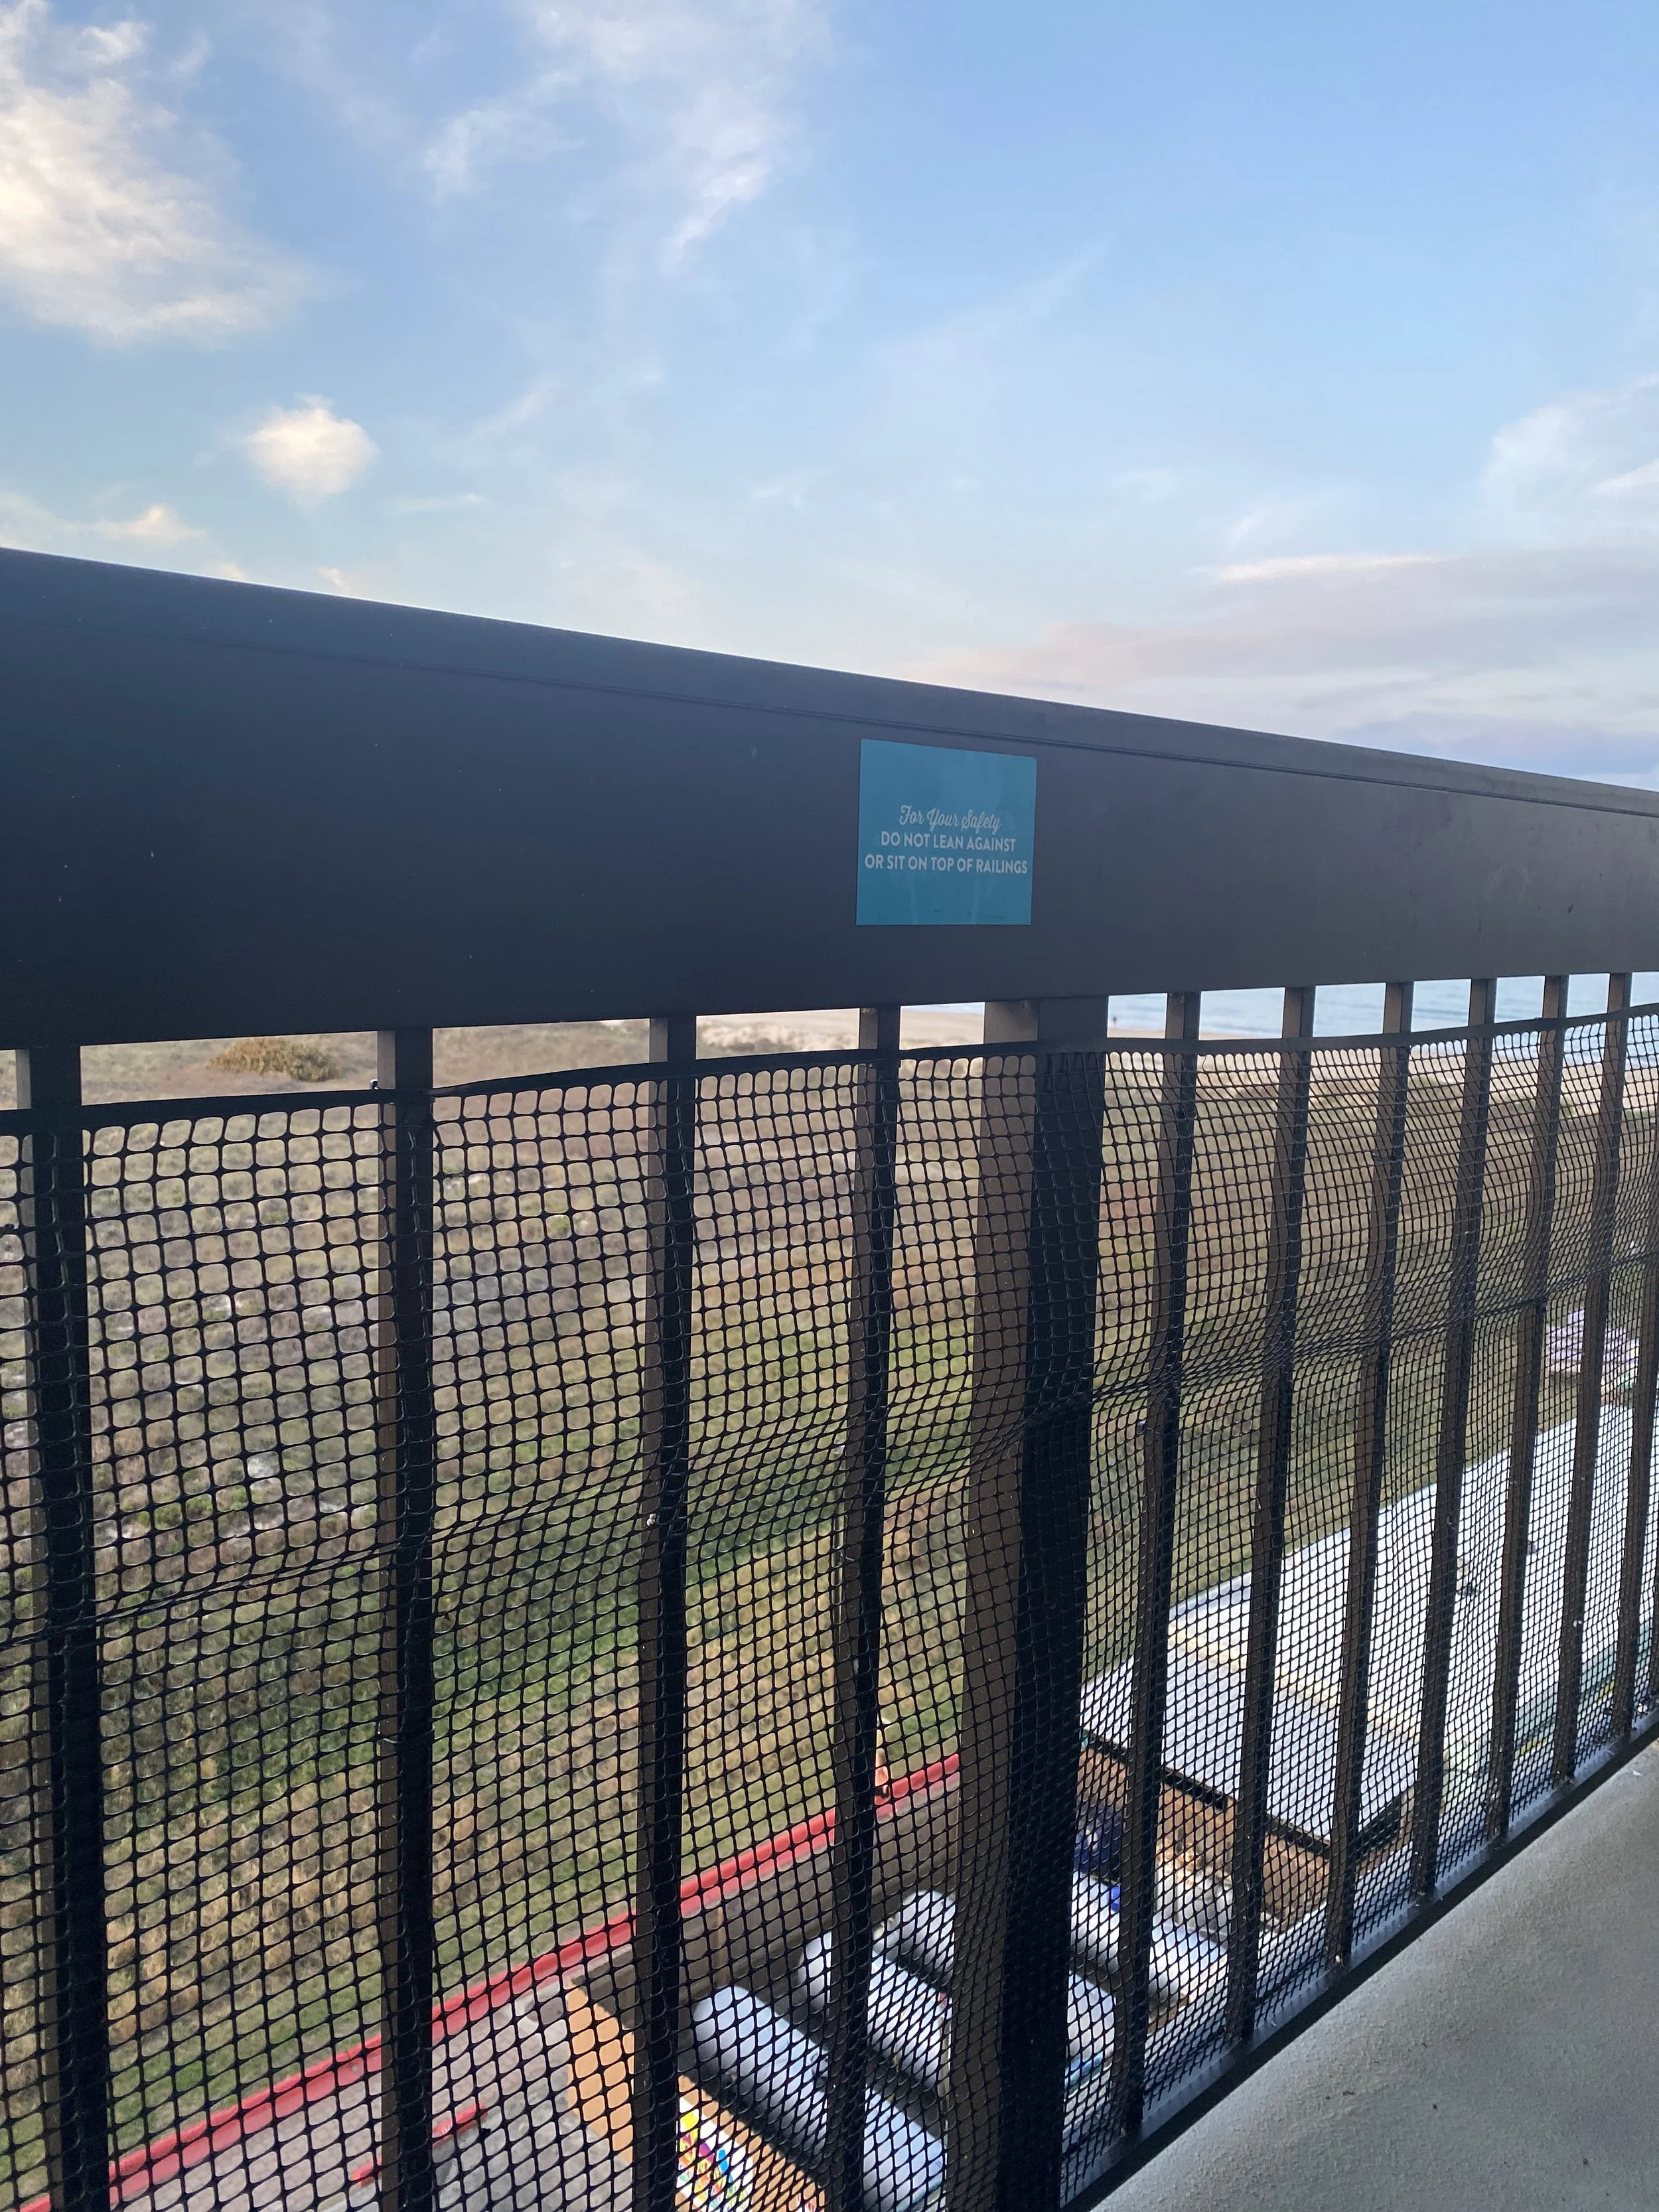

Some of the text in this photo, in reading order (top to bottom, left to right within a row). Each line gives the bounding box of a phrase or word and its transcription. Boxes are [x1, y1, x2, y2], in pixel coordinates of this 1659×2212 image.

[899, 805, 1001, 834] For Your Safety
[881, 831, 1016, 852] DO NOT LEAN AGAINST
[865, 853, 1028, 874] OR SIT ON TOP OF RAILINGS
